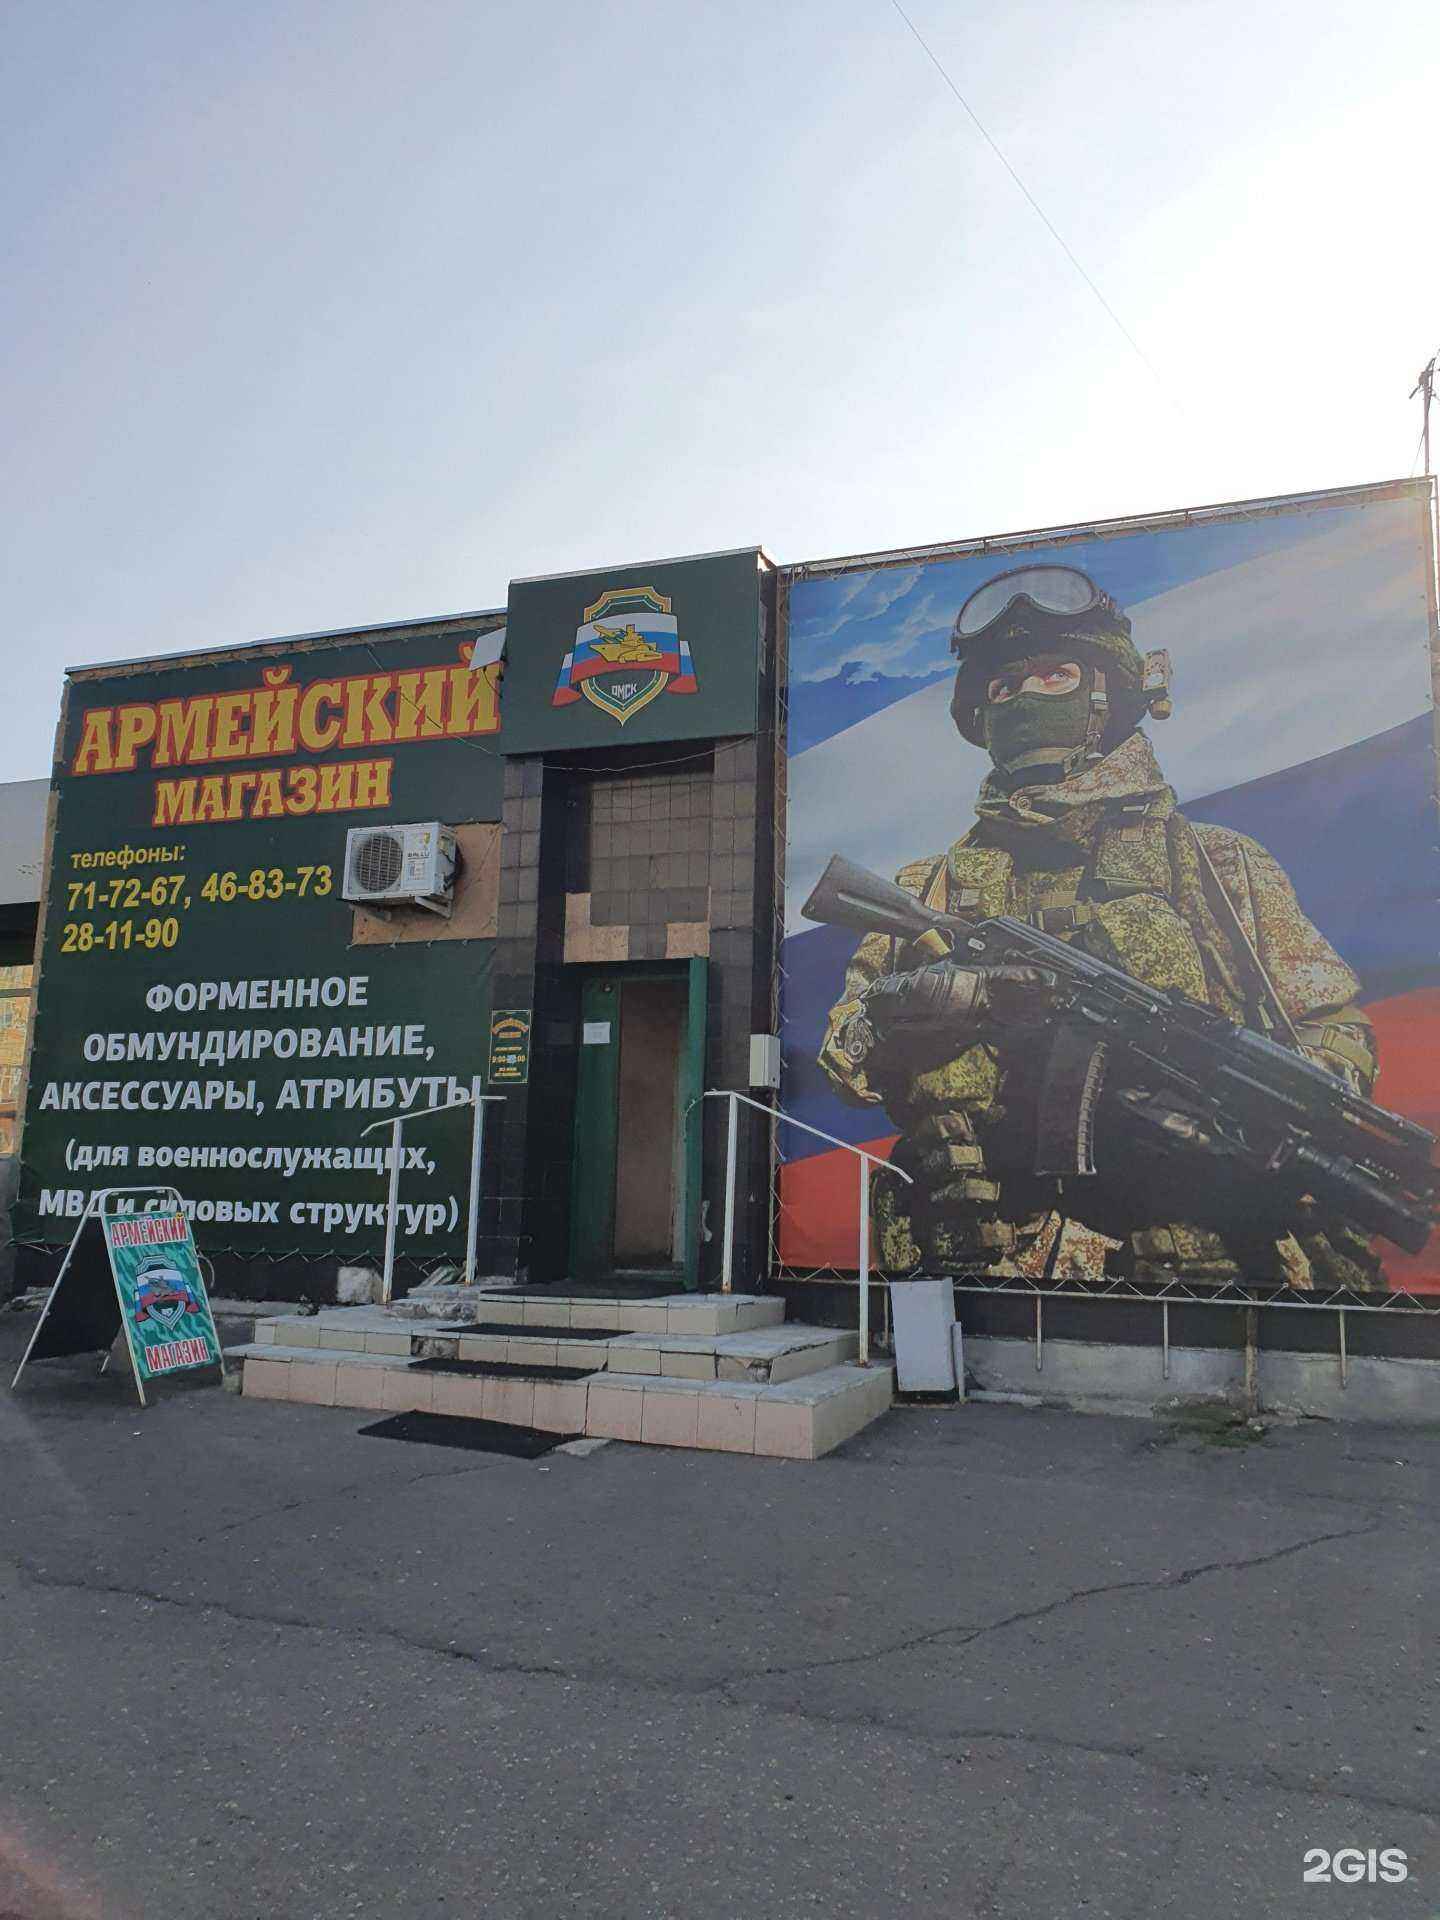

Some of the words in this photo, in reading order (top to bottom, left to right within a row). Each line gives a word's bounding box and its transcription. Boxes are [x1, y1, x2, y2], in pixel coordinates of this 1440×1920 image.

[72, 641, 503, 776] АРМЕЙСКИЙ
[152, 757, 394, 828] МАГАЗИН
[71, 844, 187, 870] телефоны:
[67, 875, 191, 911] 71-72-67,
[201, 864, 332, 902] 46-83-73
[61, 917, 179, 952] 28-11-90
[146, 976, 369, 1012] ФОРМЕННОЕ
[83, 1024, 436, 1067] ОБМУНДИРОВАНИЕ,
[39, 1080, 265, 1116] АКСЕССУАРЫ,
[275, 1076, 481, 1109] АТРИБУТЫ
[65, 1138, 129, 1171] (для
[138, 1146, 436, 1177] военнослужащих,
[111, 1213, 188, 1247] АРМЕЙСКИЙ
[145, 1337, 210, 1372] МАГАЗИН
